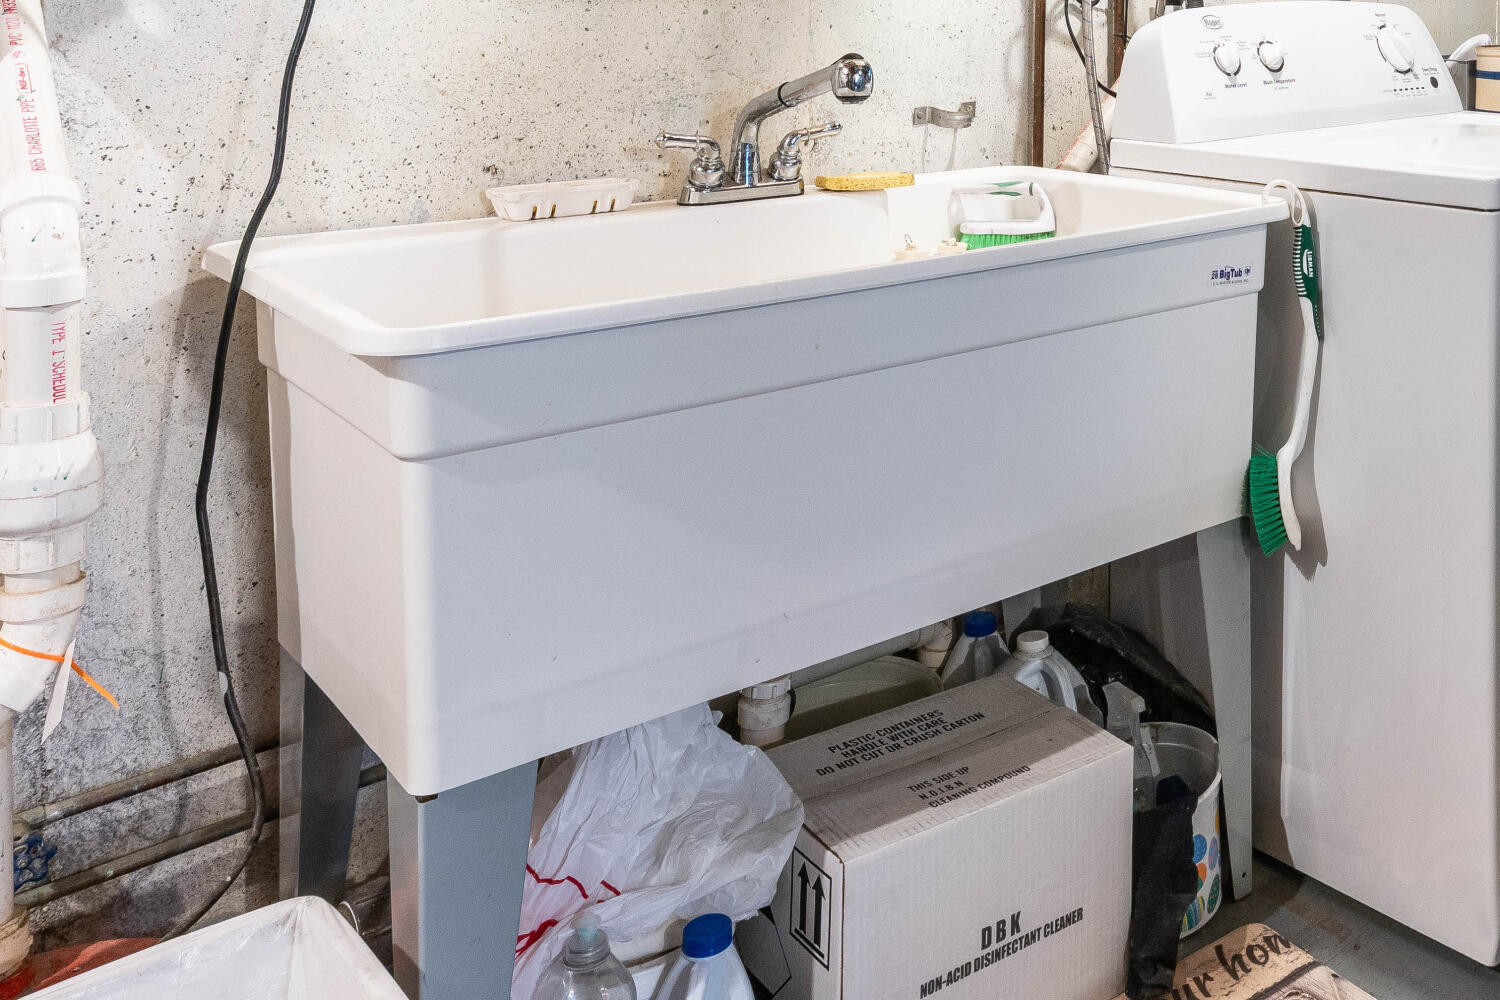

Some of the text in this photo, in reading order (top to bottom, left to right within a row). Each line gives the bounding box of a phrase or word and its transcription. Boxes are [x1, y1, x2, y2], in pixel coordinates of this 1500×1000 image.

[22, 116, 43, 156] CHARLOTTE
[1219, 268, 1243, 280] BigTub
[51, 321, 66, 345] TYPE
[816, 712, 986, 776] DO NOT CUT OR CRUSH CARTON
[828, 709, 944, 753] PLASTIC CONTAINERS
[841, 717, 948, 759] HANDLE WITH CARE
[907, 766, 969, 792] THIS SIDE UP
[928, 765, 1031, 808] CLEANING COMPOUND
[919, 907, 1083, 999] NON-ACID DISINFECTANT CLEANER
